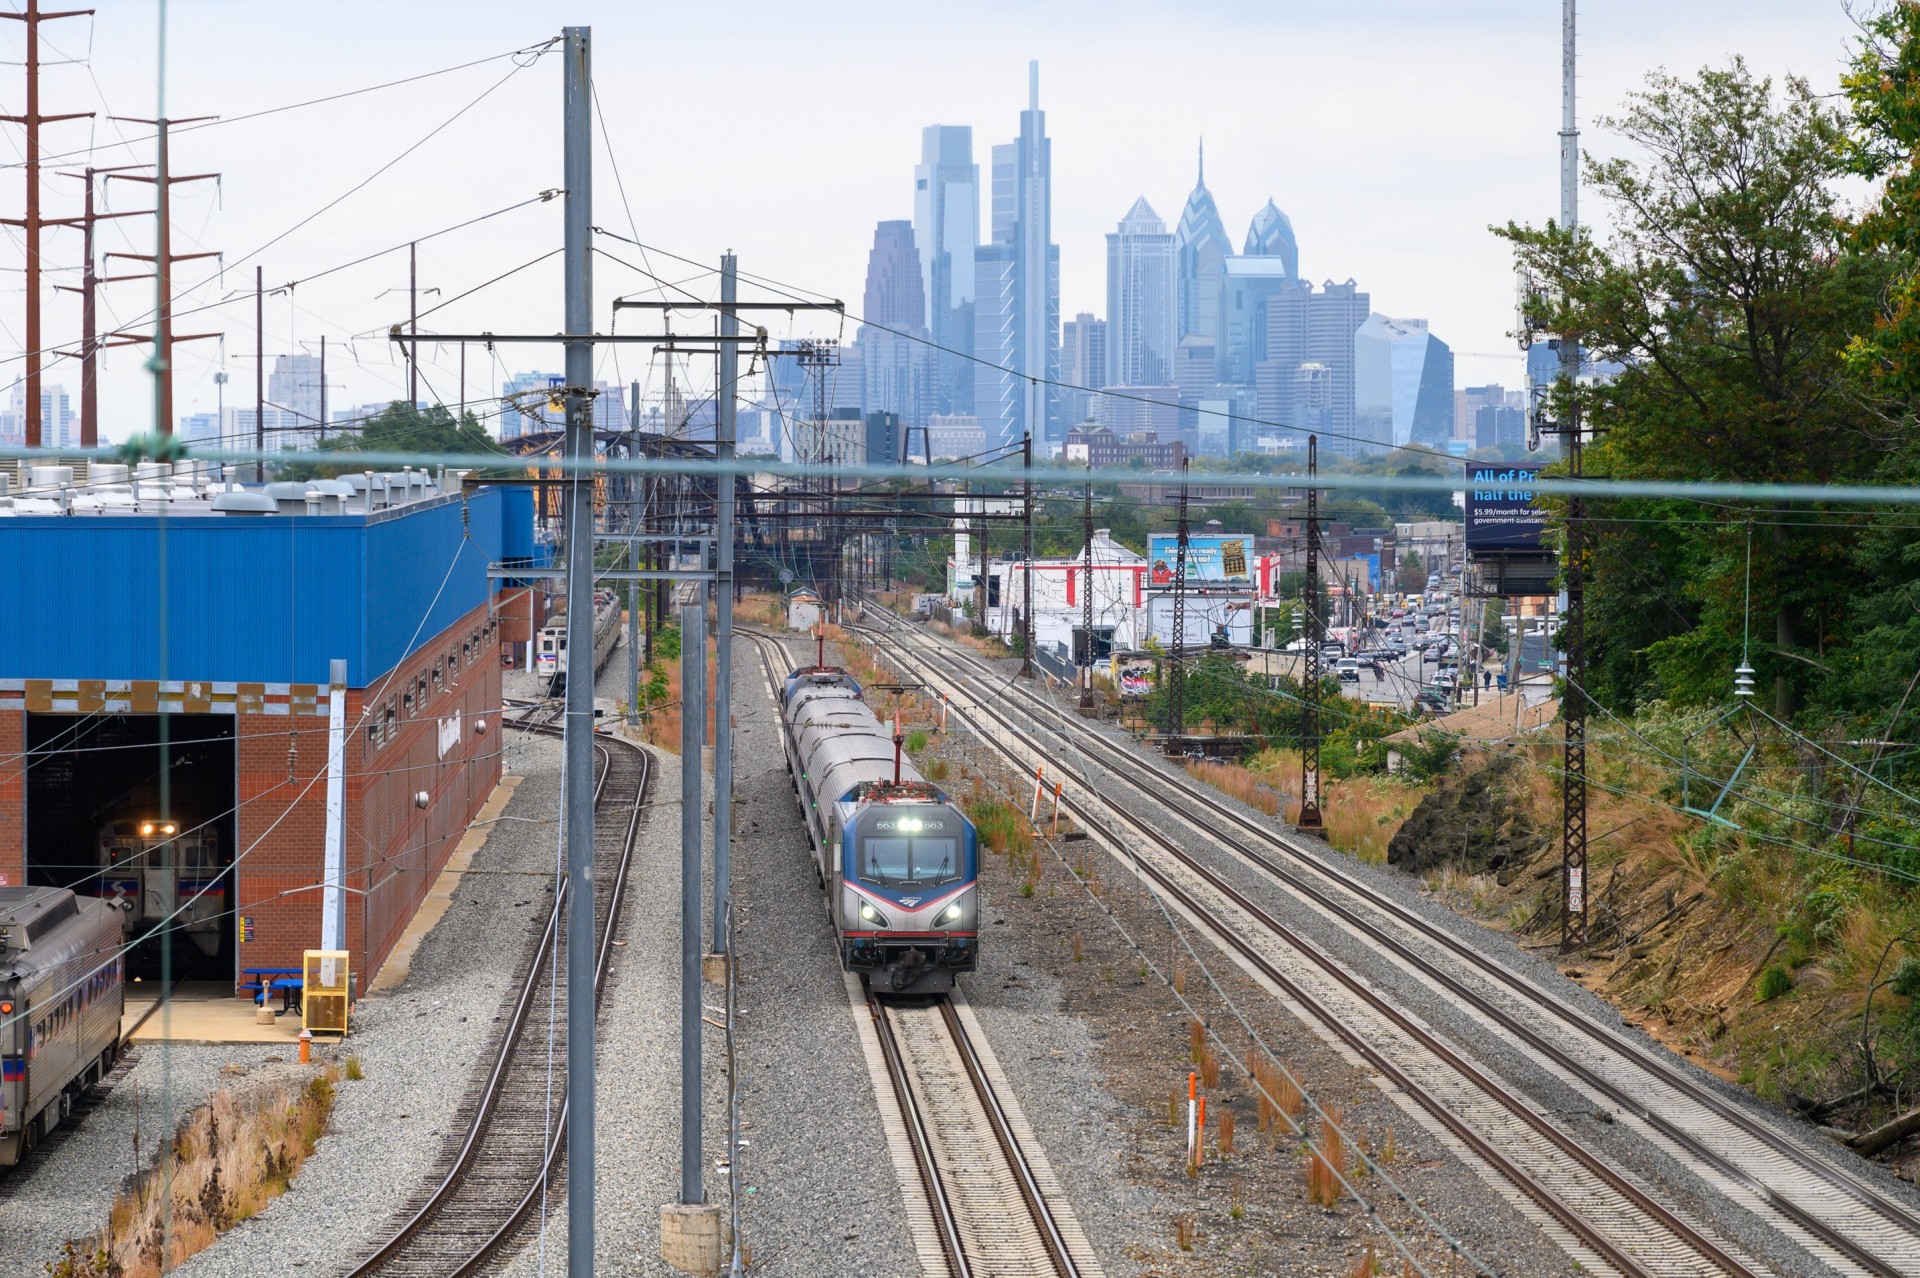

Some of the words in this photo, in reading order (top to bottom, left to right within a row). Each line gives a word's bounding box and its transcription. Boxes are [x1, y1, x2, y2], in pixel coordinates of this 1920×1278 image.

[1474, 470, 1494, 483] All
[1499, 470, 1514, 483] of
[1474, 487, 1503, 501] half
[1508, 488, 1532, 501] the
[1474, 508, 1518, 516] $5.99/month
[1520, 508, 1529, 516] for
[1198, 547, 1217, 555] really
[1171, 555, 1197, 563] loing
[1198, 555, 1211, 564] up!
[877, 821, 896, 830] 663
[924, 821, 943, 830] 663
